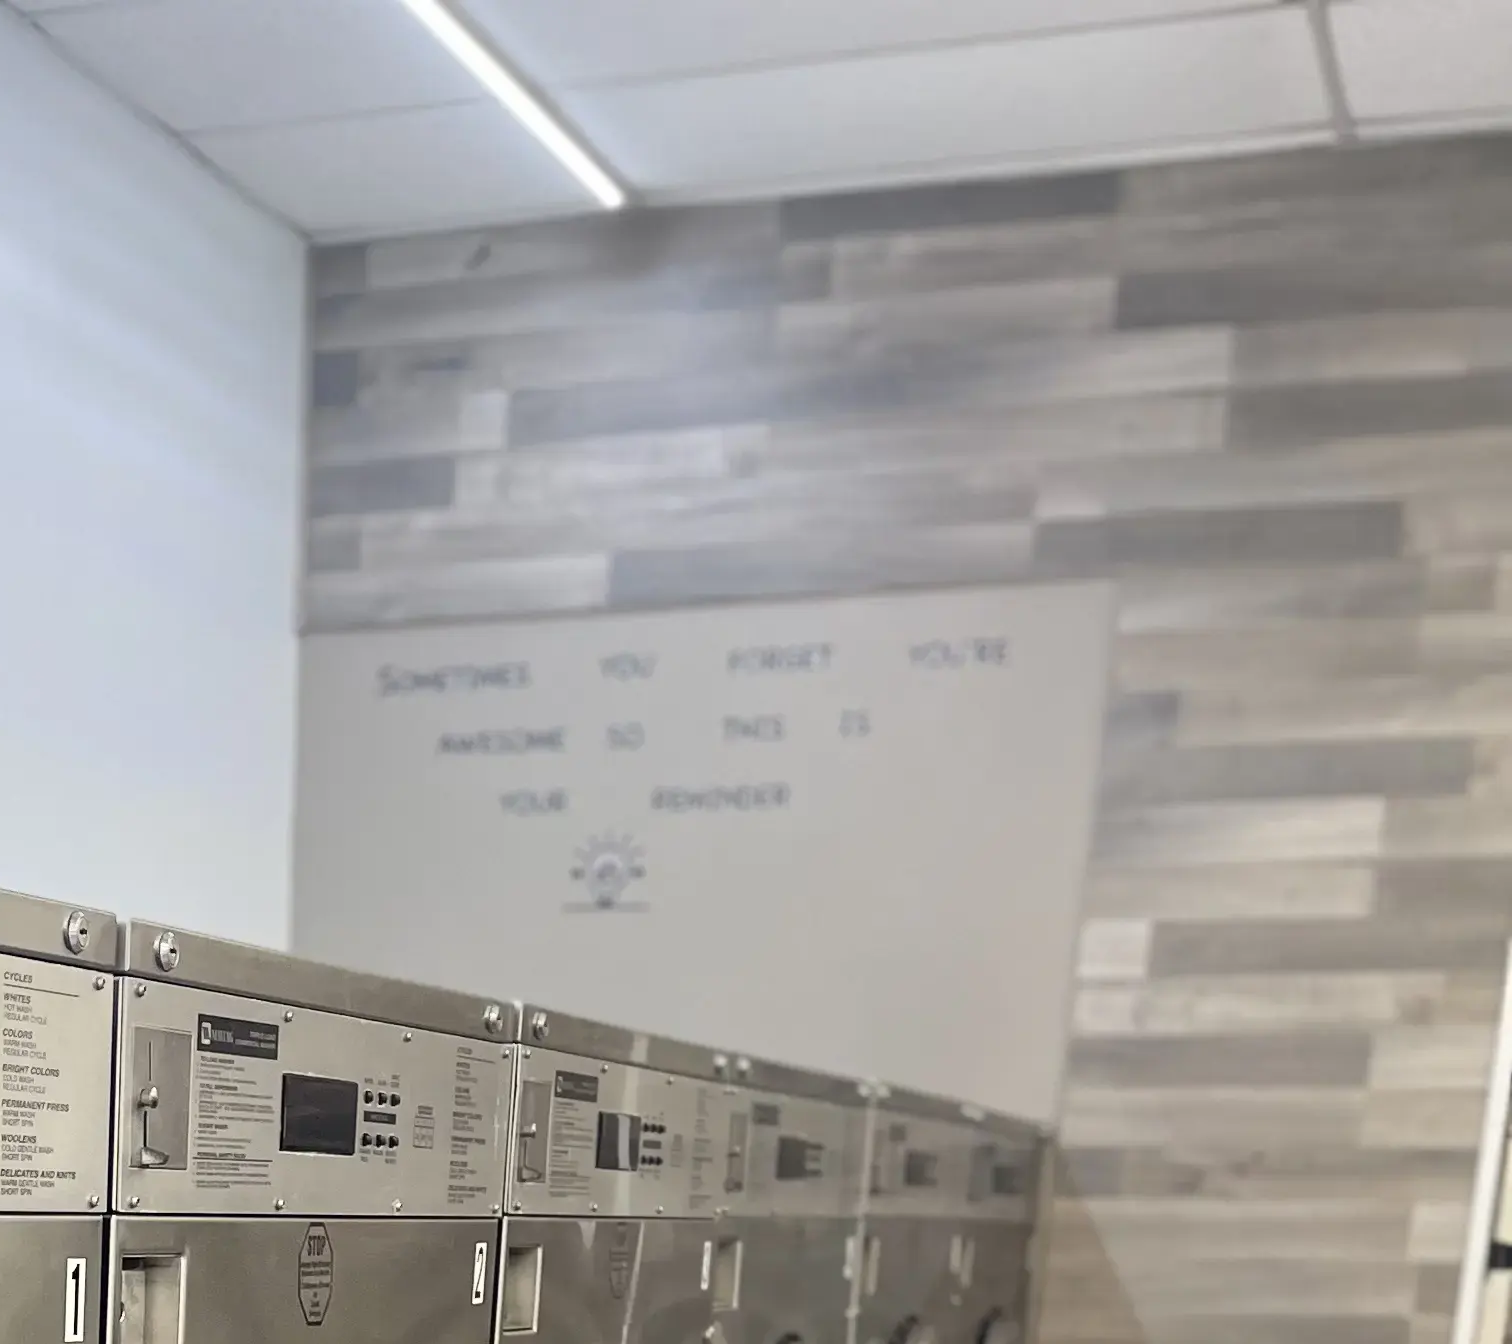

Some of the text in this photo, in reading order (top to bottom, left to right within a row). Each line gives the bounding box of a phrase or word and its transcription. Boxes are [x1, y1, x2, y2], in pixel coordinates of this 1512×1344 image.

[4, 972, 32, 983] CYCLES
[4, 993, 31, 1004] WHITES
[3, 1028, 33, 1039] COLORS
[2, 1064, 59, 1077] BRIGHT COLORS
[2, 1099, 69, 1112] PERMANENT PRESS
[1, 1134, 36, 1144] WOOLENS
[0, 1169, 76, 1180] DELICATES AND KNITS
[307, 1235, 326, 1256] STOP
[474, 1246, 484, 1299] 2
[72, 1264, 80, 1335] 1
